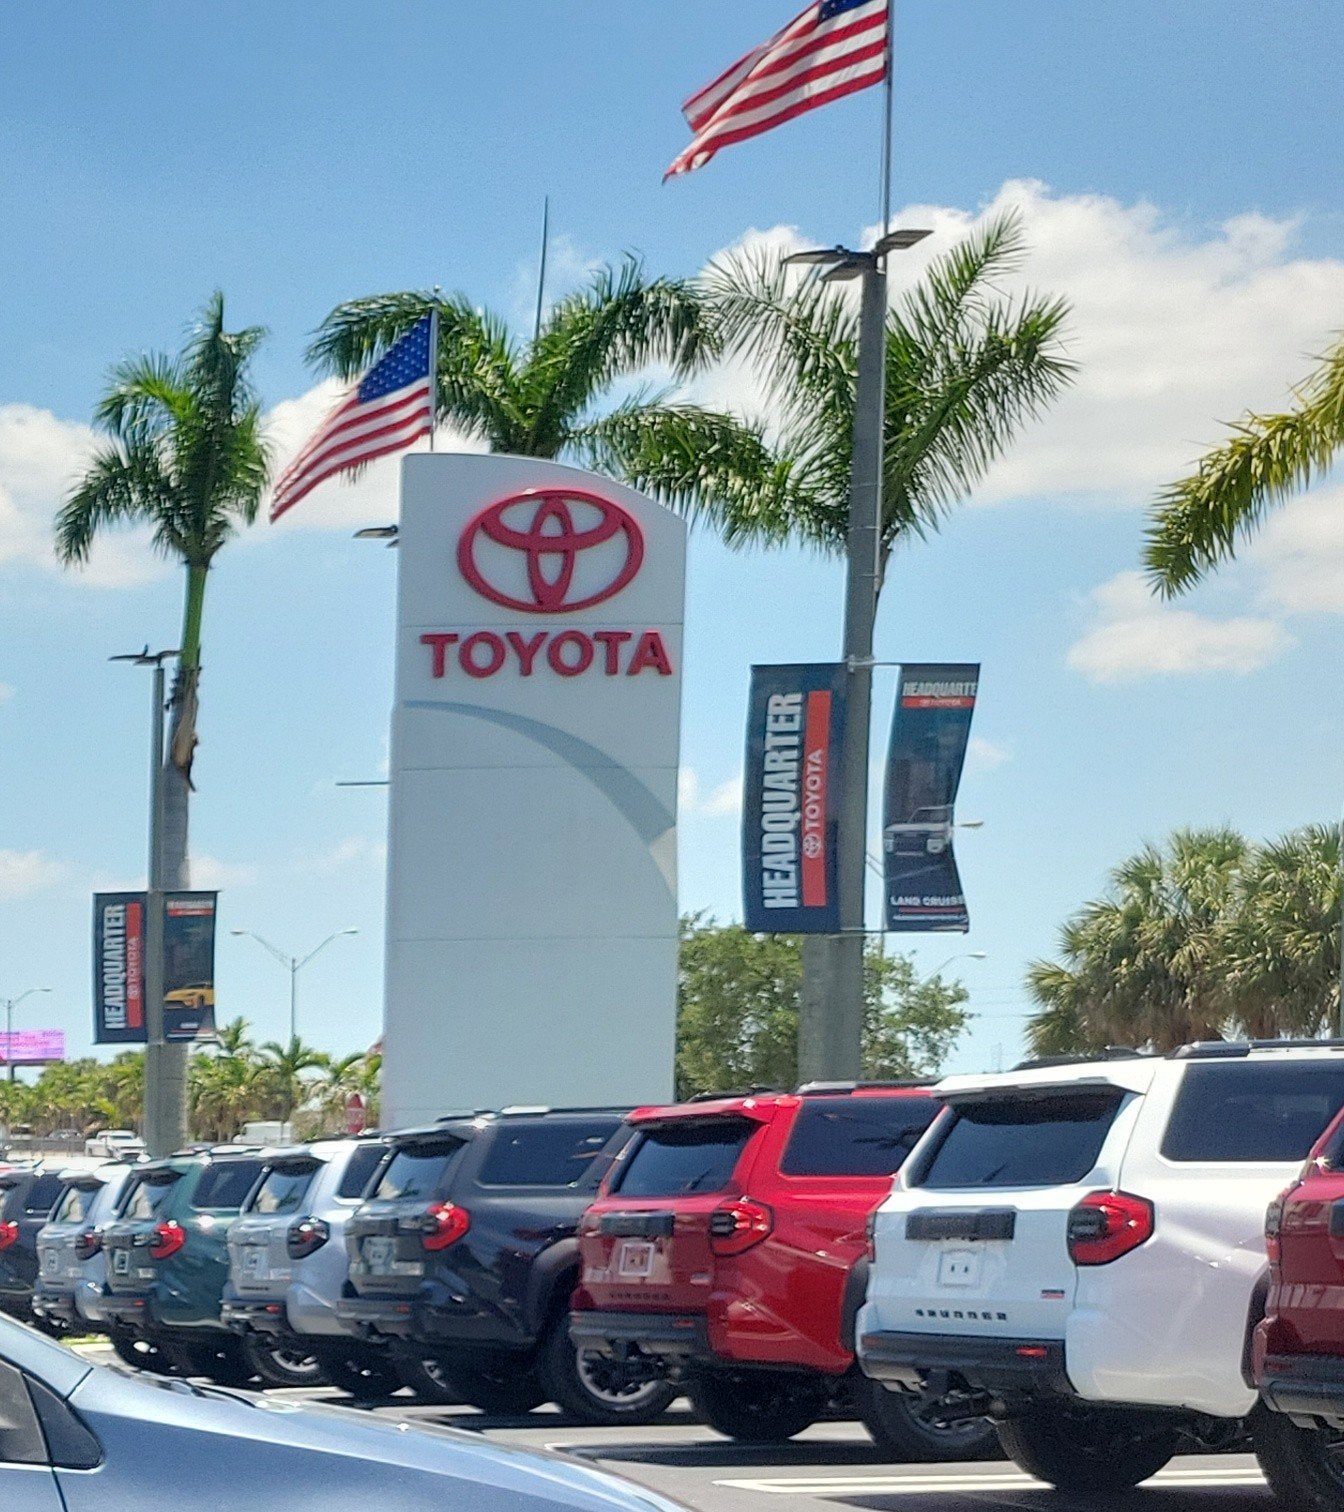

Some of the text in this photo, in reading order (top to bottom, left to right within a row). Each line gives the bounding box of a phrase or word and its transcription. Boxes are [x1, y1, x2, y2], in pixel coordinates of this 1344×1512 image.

[421, 630, 673, 679] TOYOTA
[760, 691, 803, 909] HEADQUARTER
[803, 749, 824, 829] TOYOTA
[103, 904, 127, 1029] HEADQUARTER
